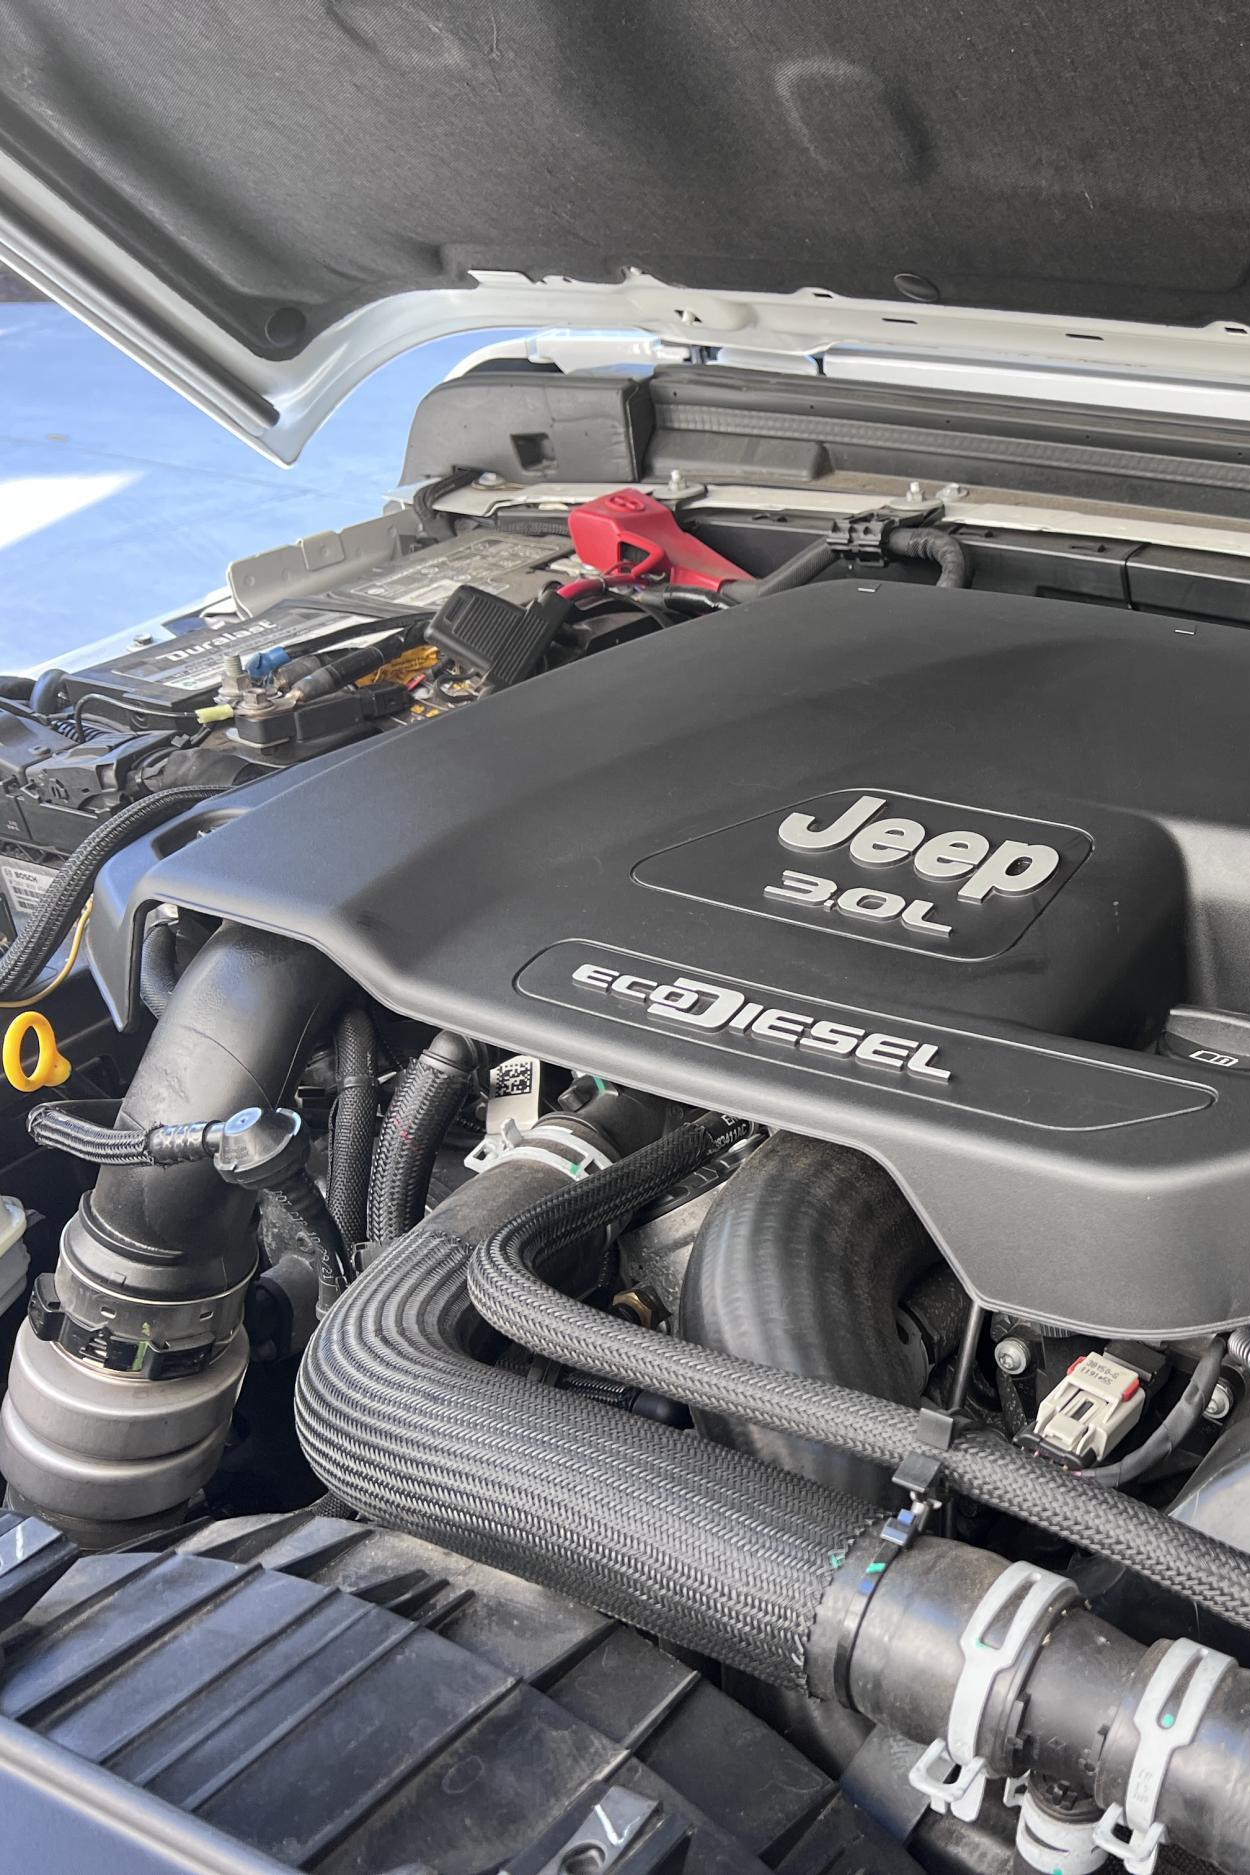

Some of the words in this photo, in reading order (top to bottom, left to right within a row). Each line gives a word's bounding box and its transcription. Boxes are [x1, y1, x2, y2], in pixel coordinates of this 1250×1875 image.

[156, 619, 277, 662] Duralast
[778, 796, 1060, 903] Jeep
[764, 870, 952, 936] 3.0L
